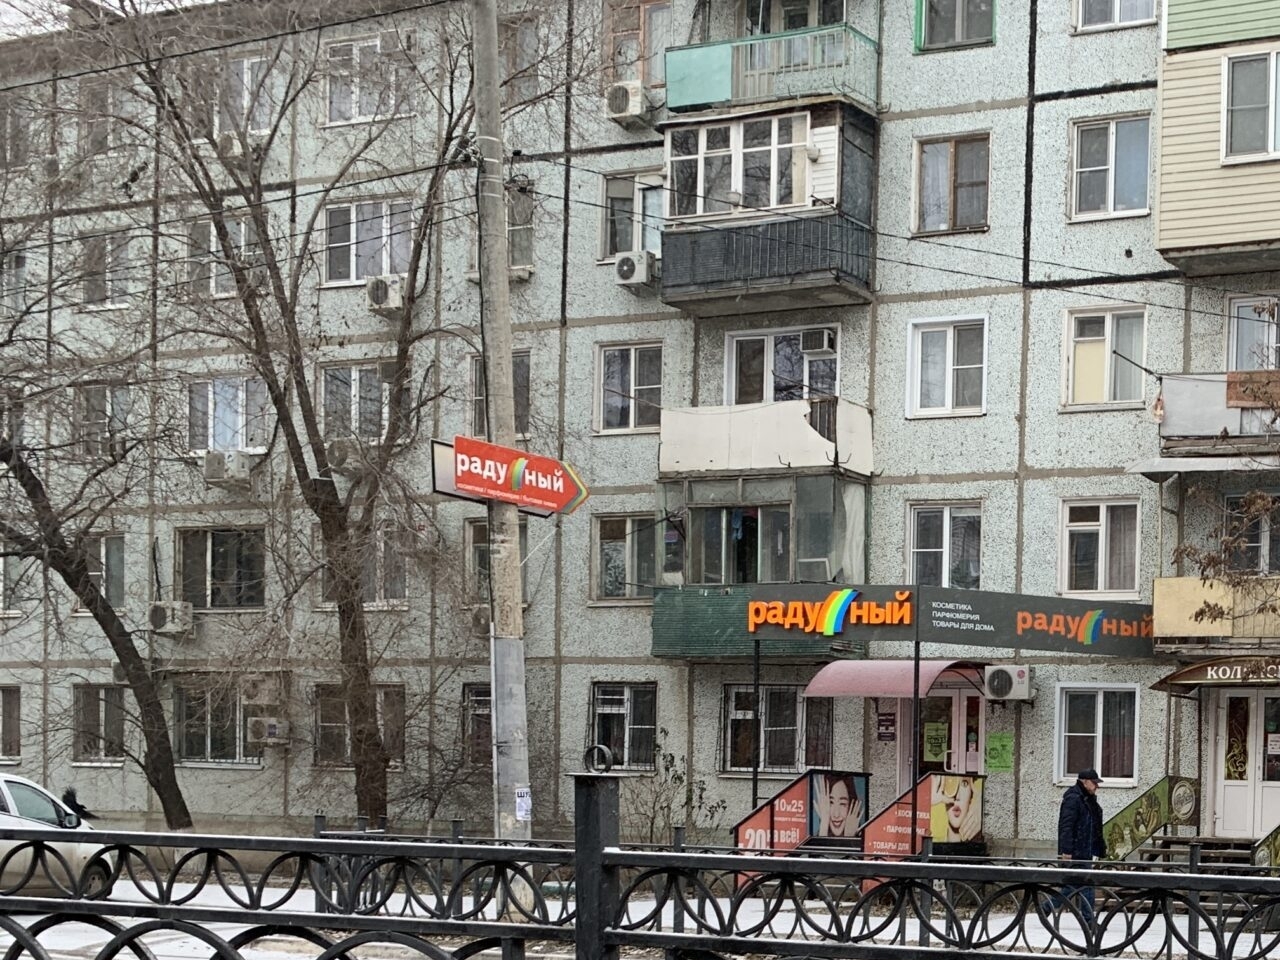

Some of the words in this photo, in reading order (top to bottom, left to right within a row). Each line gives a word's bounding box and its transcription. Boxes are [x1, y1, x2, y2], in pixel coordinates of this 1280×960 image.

[931, 602, 973, 611] КОСМЕТИКА
[931, 611, 980, 621] ПАРФЮМЕРИЯ
[931, 620, 960, 629] ТОВАРЫ
[960, 622, 974, 630] ДЛЯ
[975, 624, 995, 632] ДОМА
